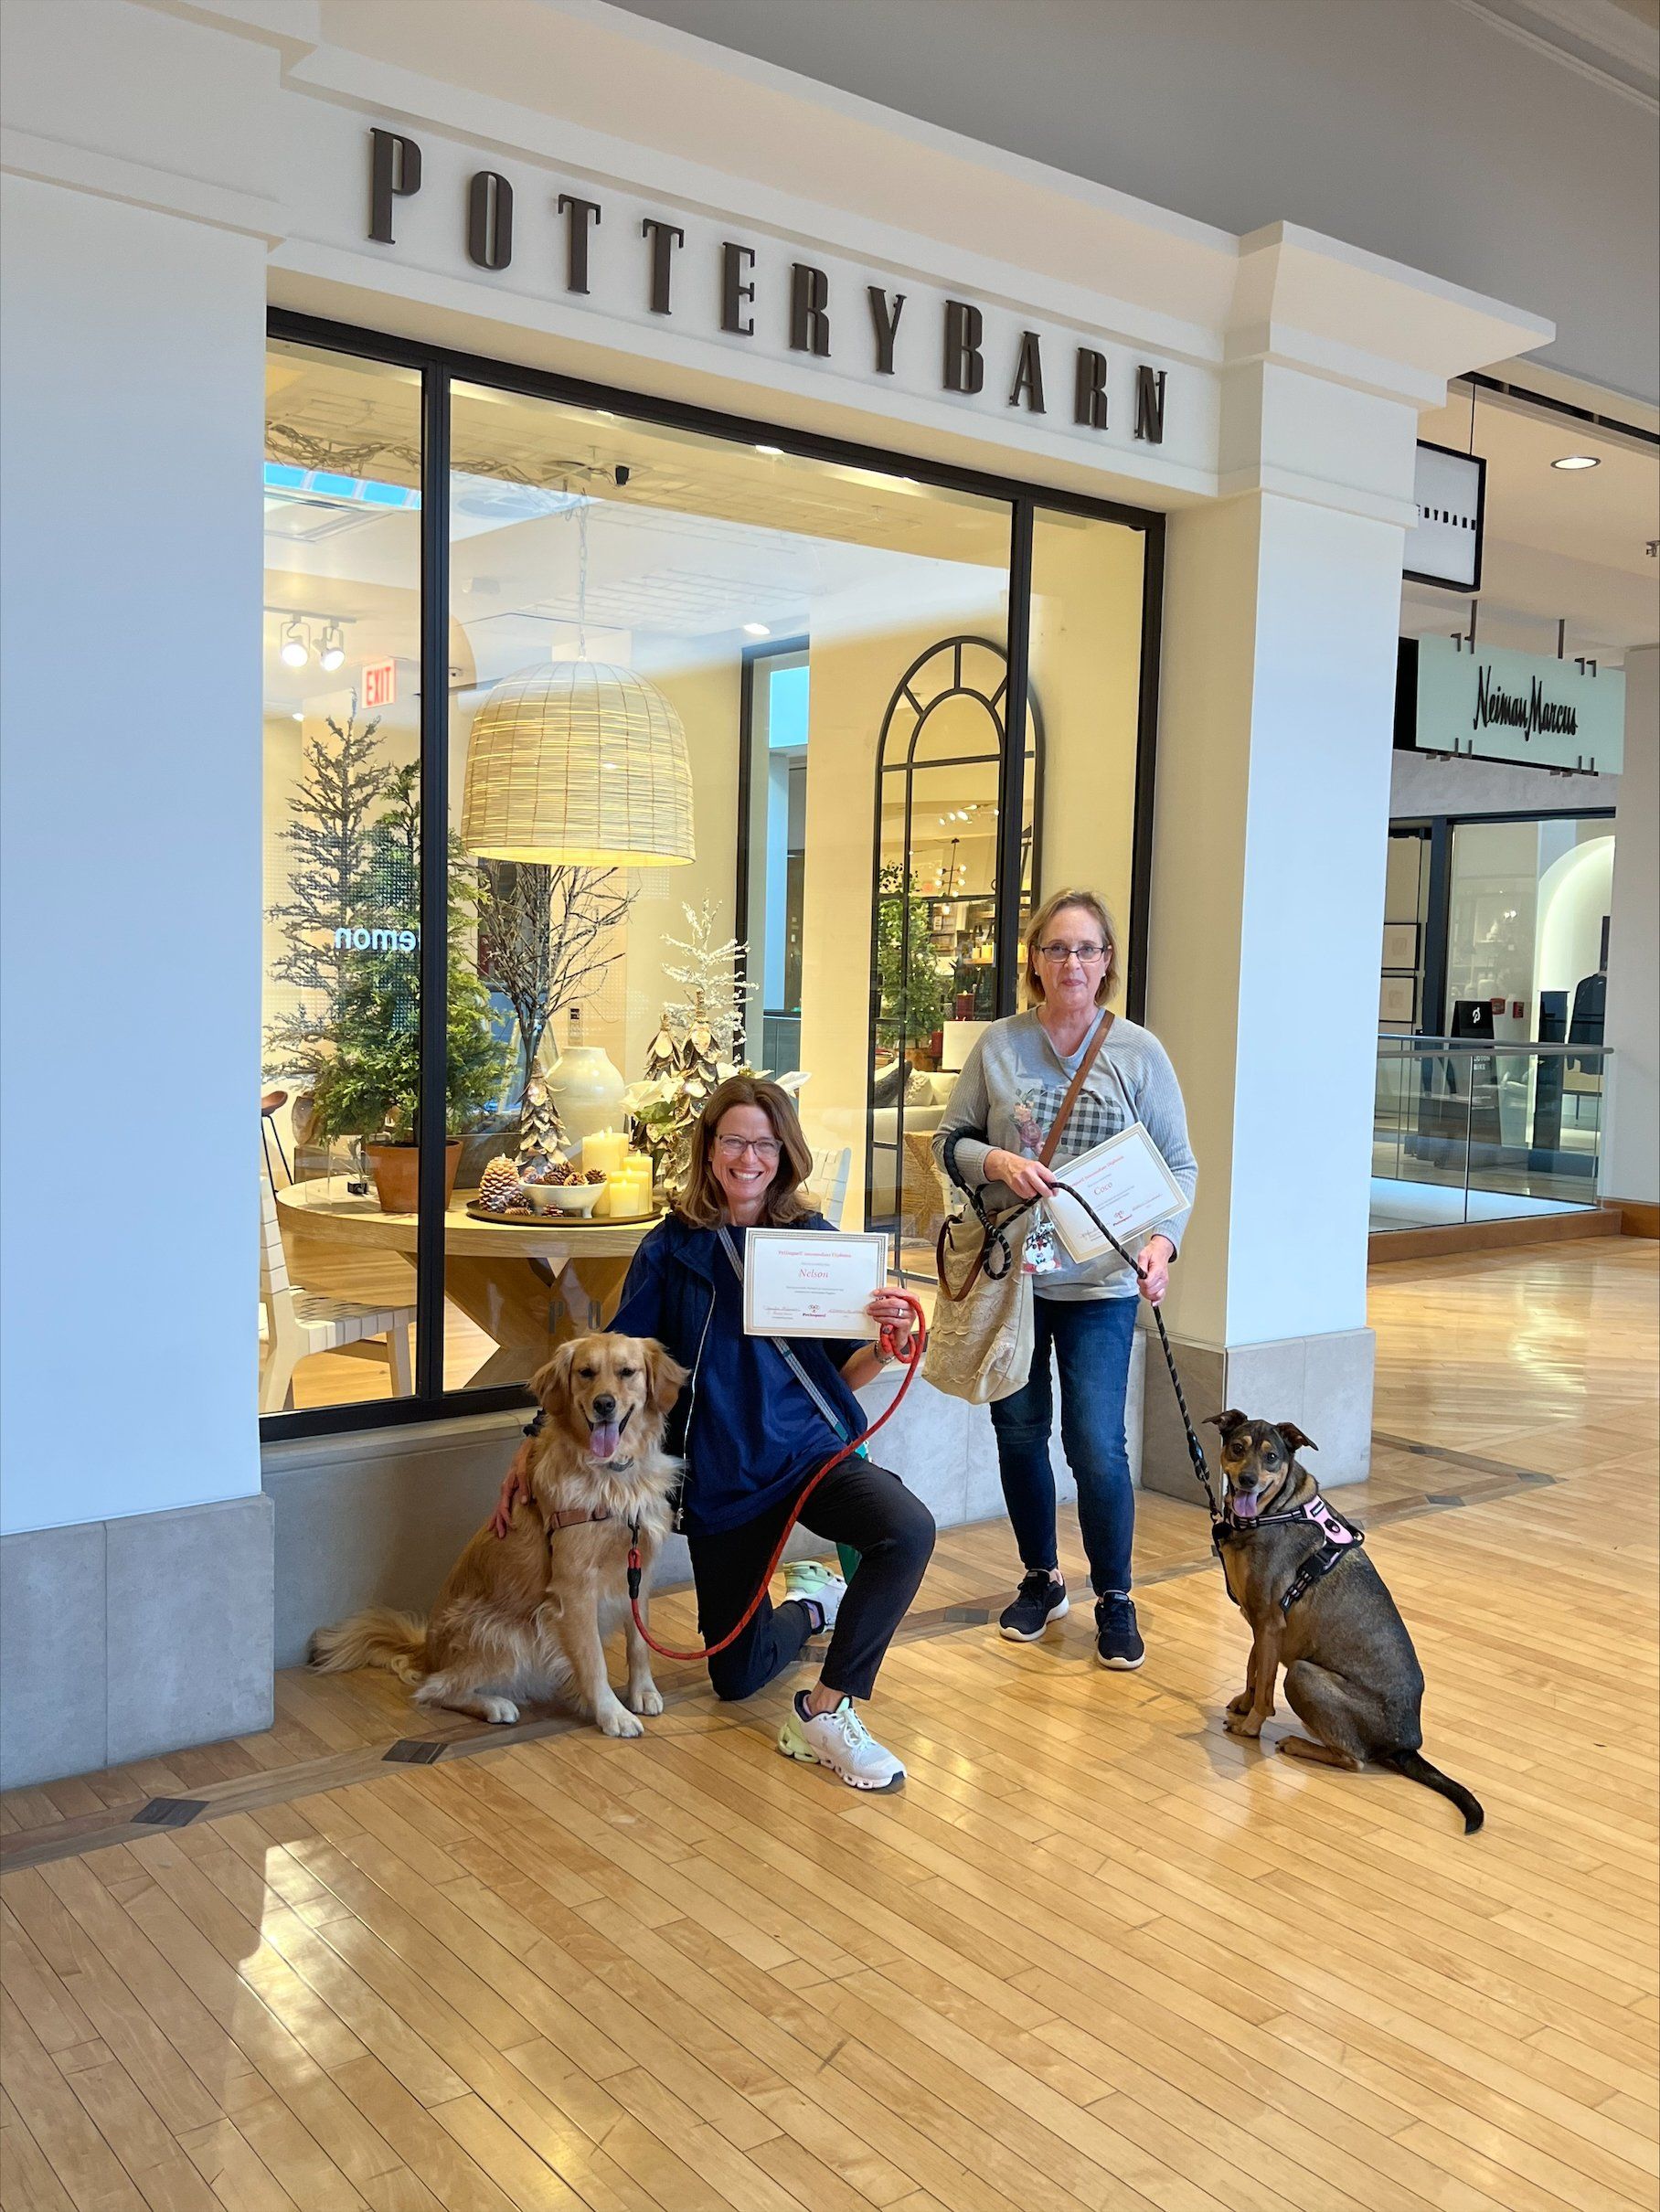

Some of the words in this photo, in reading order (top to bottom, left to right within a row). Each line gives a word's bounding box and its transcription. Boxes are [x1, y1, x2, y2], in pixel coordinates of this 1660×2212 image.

[367, 666, 391, 706] EXIT
[1473, 665, 1527, 730] Neiman
[1525, 675, 1578, 741] Marcus
[1093, 1181, 1113, 1196] Coco
[799, 1269, 829, 1279] Nelson
